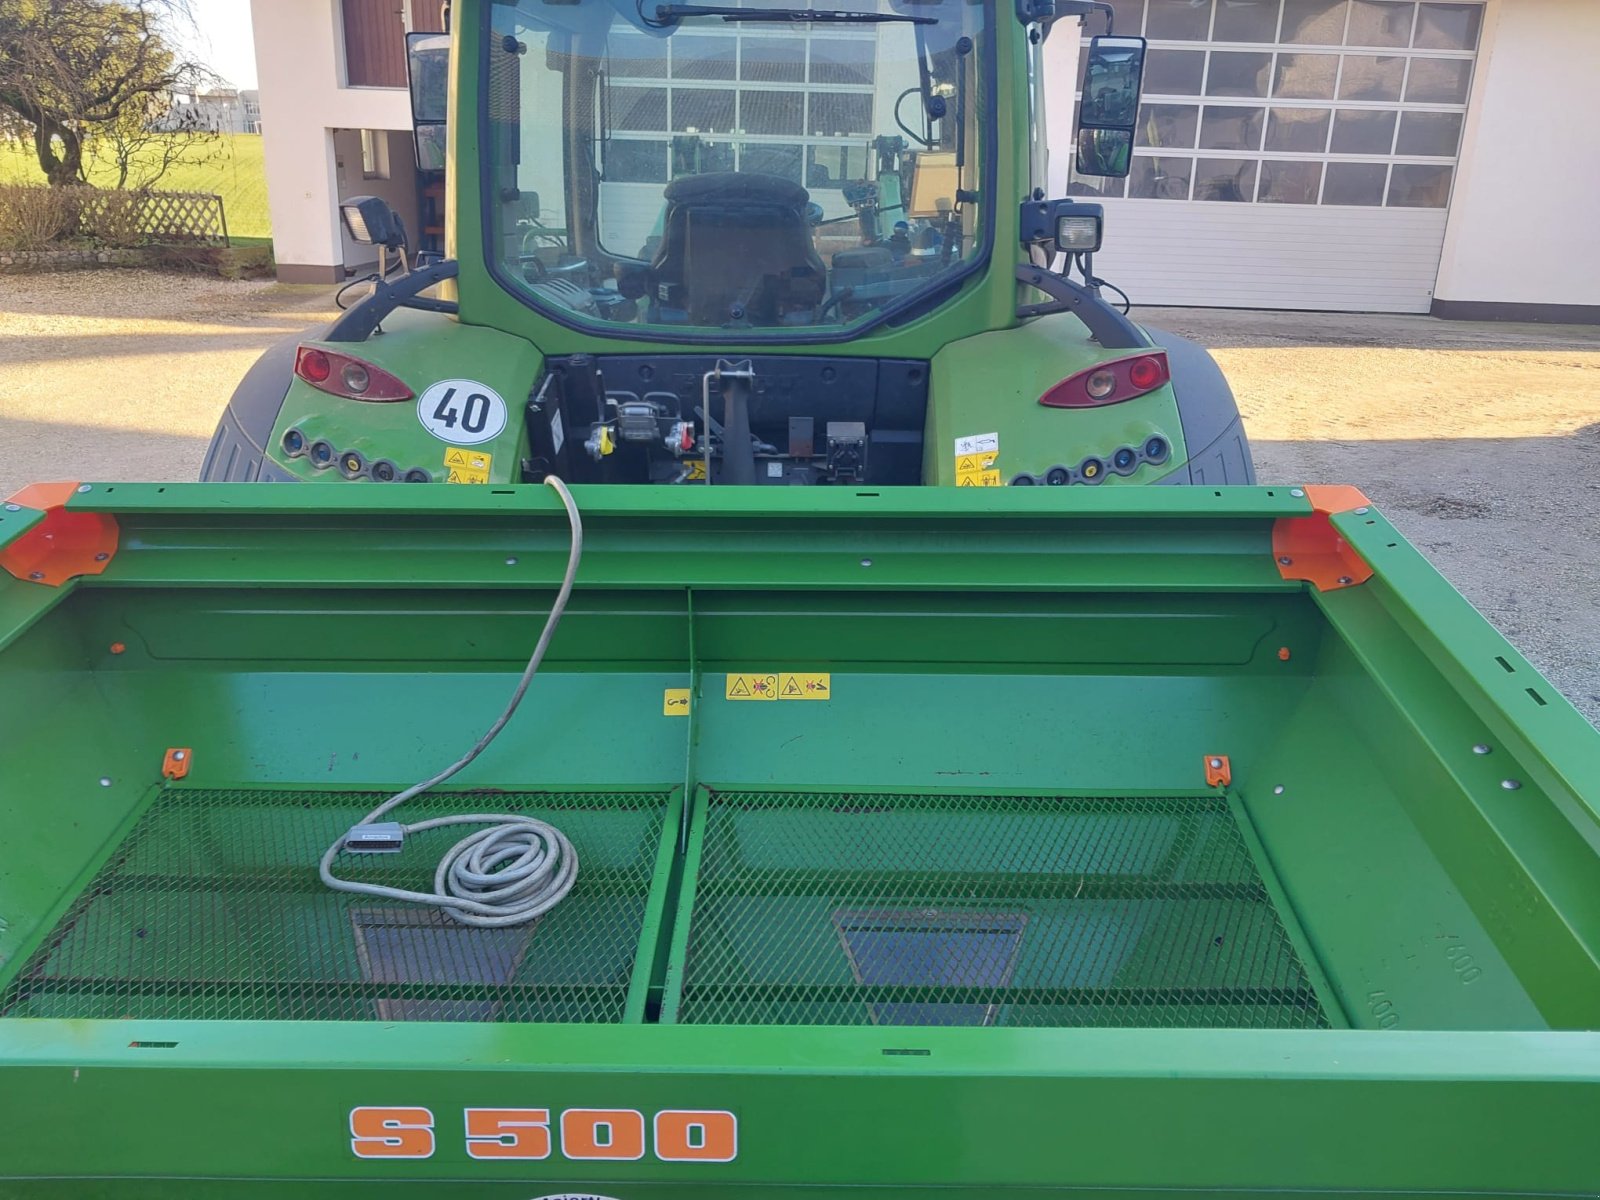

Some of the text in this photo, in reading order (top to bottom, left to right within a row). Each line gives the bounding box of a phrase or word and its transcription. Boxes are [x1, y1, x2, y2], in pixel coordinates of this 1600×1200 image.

[433, 388, 491, 433] 40
[349, 1106, 738, 1162] S 500
